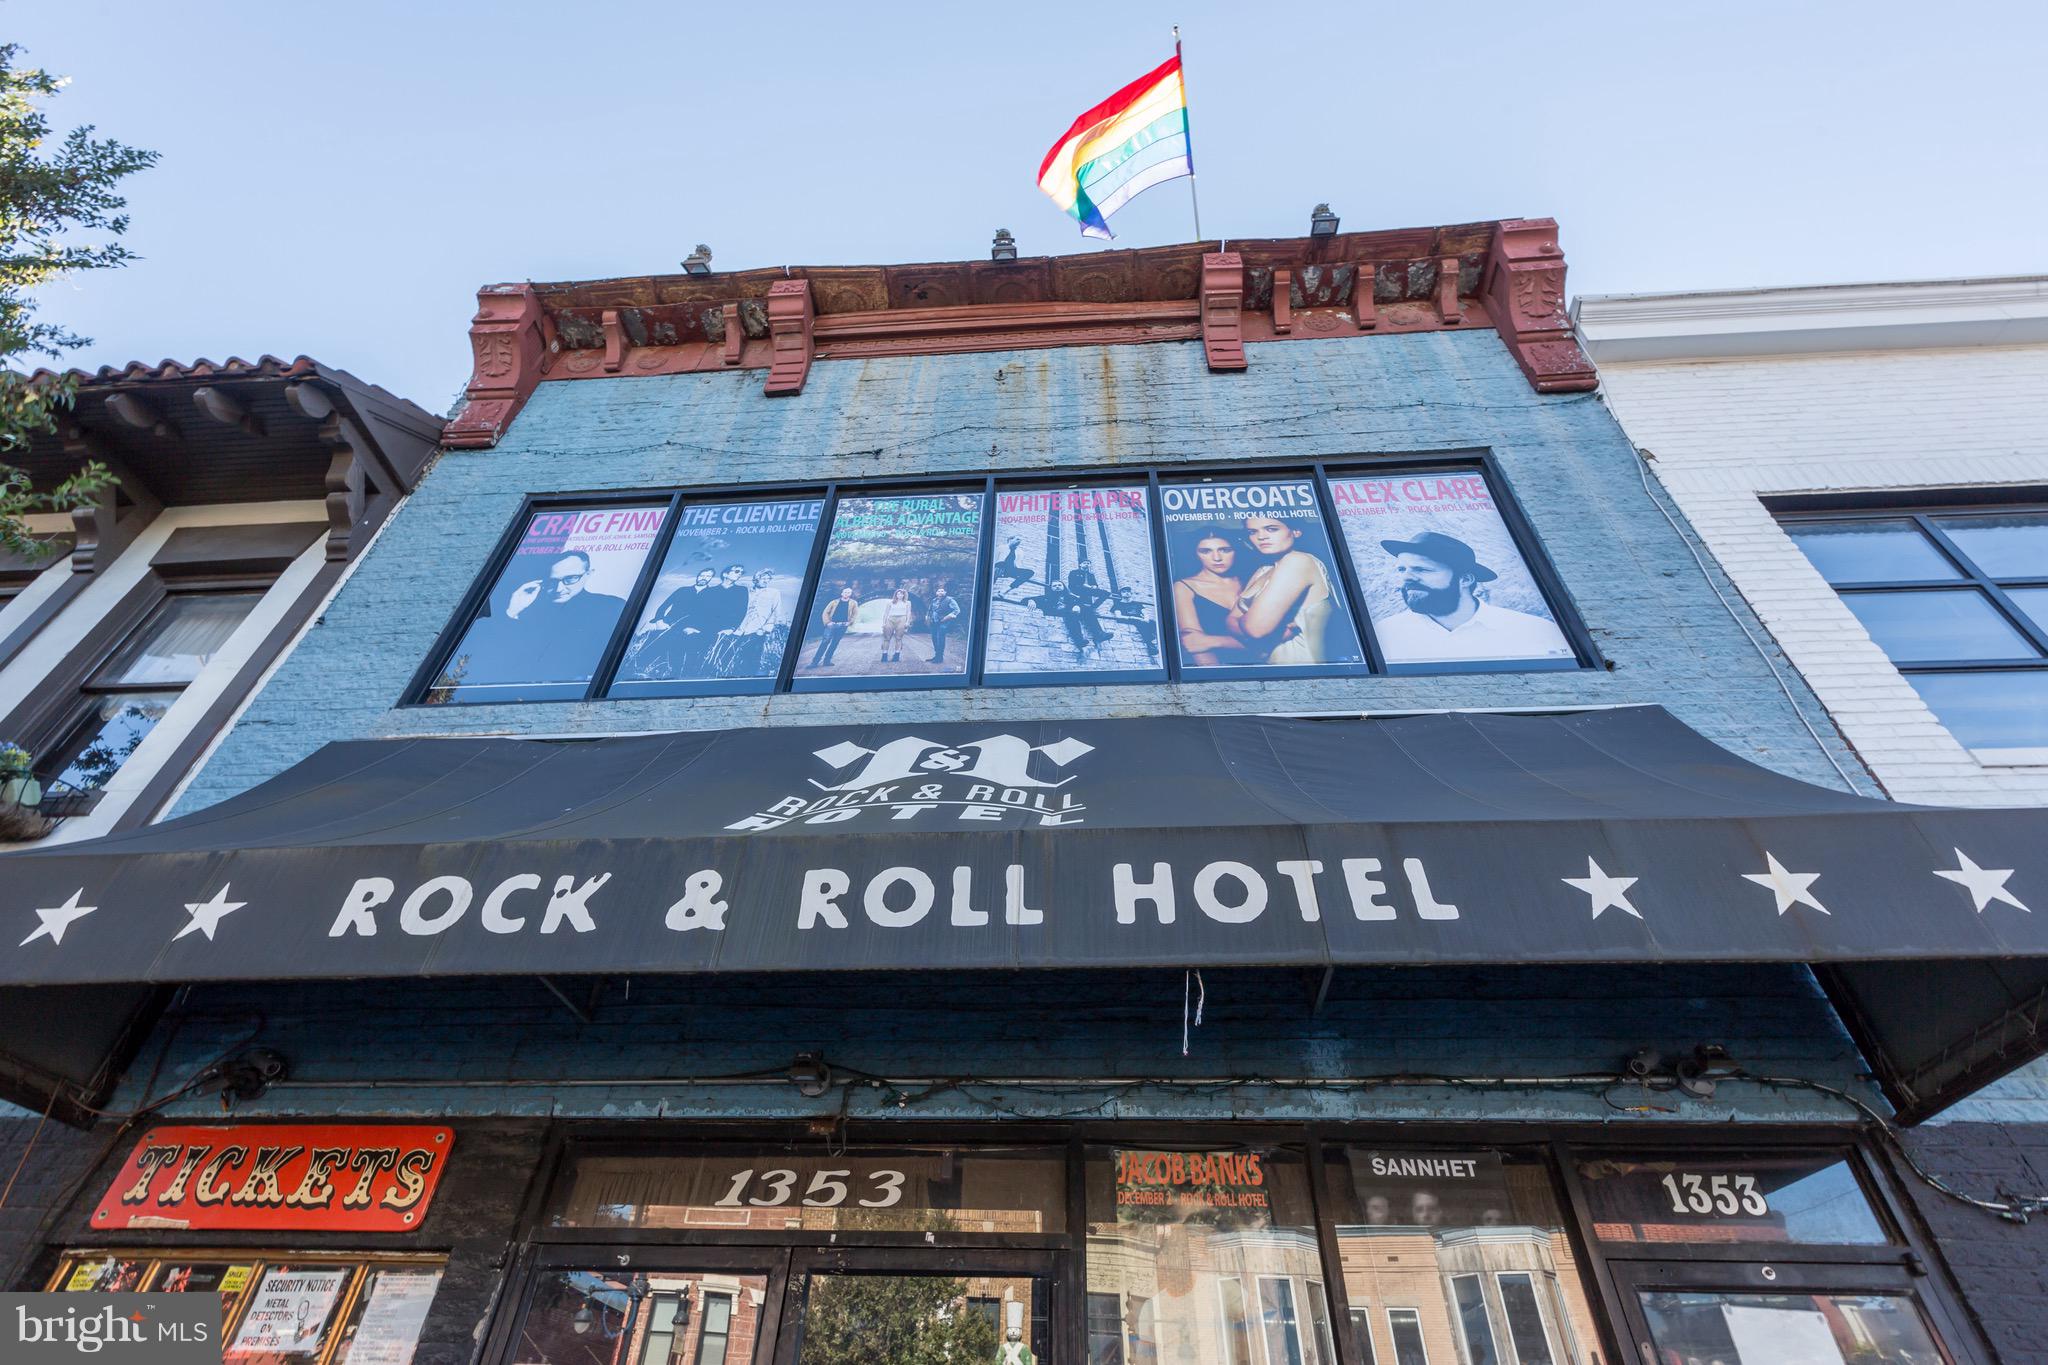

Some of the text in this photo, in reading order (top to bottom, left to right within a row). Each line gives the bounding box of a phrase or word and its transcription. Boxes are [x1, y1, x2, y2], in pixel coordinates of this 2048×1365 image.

[1163, 485, 1313, 510] OVERCOATS
[1334, 477, 1489, 505] ALEX CLARE
[874, 498, 945, 512] THE RURAL
[1000, 491, 1144, 512] WHITE REAPER
[1338, 507, 1386, 516] NOVEMBER
[1408, 504, 1433, 513] ROCK
[1442, 503, 1464, 512] ROLL
[1466, 502, 1495, 511] HOTEL
[683, 503, 821, 526] THE CLIENTELE
[835, 511, 979, 528] ALBERTA ADVANTAGE
[1001, 515, 1046, 524] NOVEMBER
[1165, 509, 1318, 522] NOVEMBER 10 ROCK & ROLL HOTEL
[528, 511, 666, 537] CRAIG FINN
[677, 527, 721, 537] NOVEMBER
[721, 527, 728, 535] 2
[736, 525, 759, 534] ROCK
[766, 525, 786, 533] ROLL
[788, 523, 814, 532] HOTEL
[949, 527, 975, 535] HOTEL
[604, 543, 623, 551] ROLL
[624, 542, 649, 550] HOTEL
[766, 784, 1083, 816] ROCK & ROLL
[723, 804, 1084, 831] HOTEL
[328, 858, 1460, 937] ROCK & ROLL HOTEL
[1117, 1152, 1264, 1186] JACOB BANKS
[1372, 1157, 1476, 1177] SANNHET
[121, 1144, 437, 1213] TICKETS
[714, 1169, 906, 1208] 1353
[1662, 1173, 1768, 1217] 1353
[1117, 1191, 1164, 1206] DECEMBER
[1180, 1192, 1204, 1207] ROCK
[1206, 1192, 1214, 1207] &
[1214, 1192, 1238, 1207] ROLL
[1238, 1193, 1268, 1207] HOTEL
[265, 1279, 336, 1293] SECURITY NOTICE
[265, 1298, 290, 1309] METAL
[250, 1311, 295, 1321] DETECTORS
[260, 1323, 273, 1334] ON
[241, 1336, 281, 1347] PREMISES
